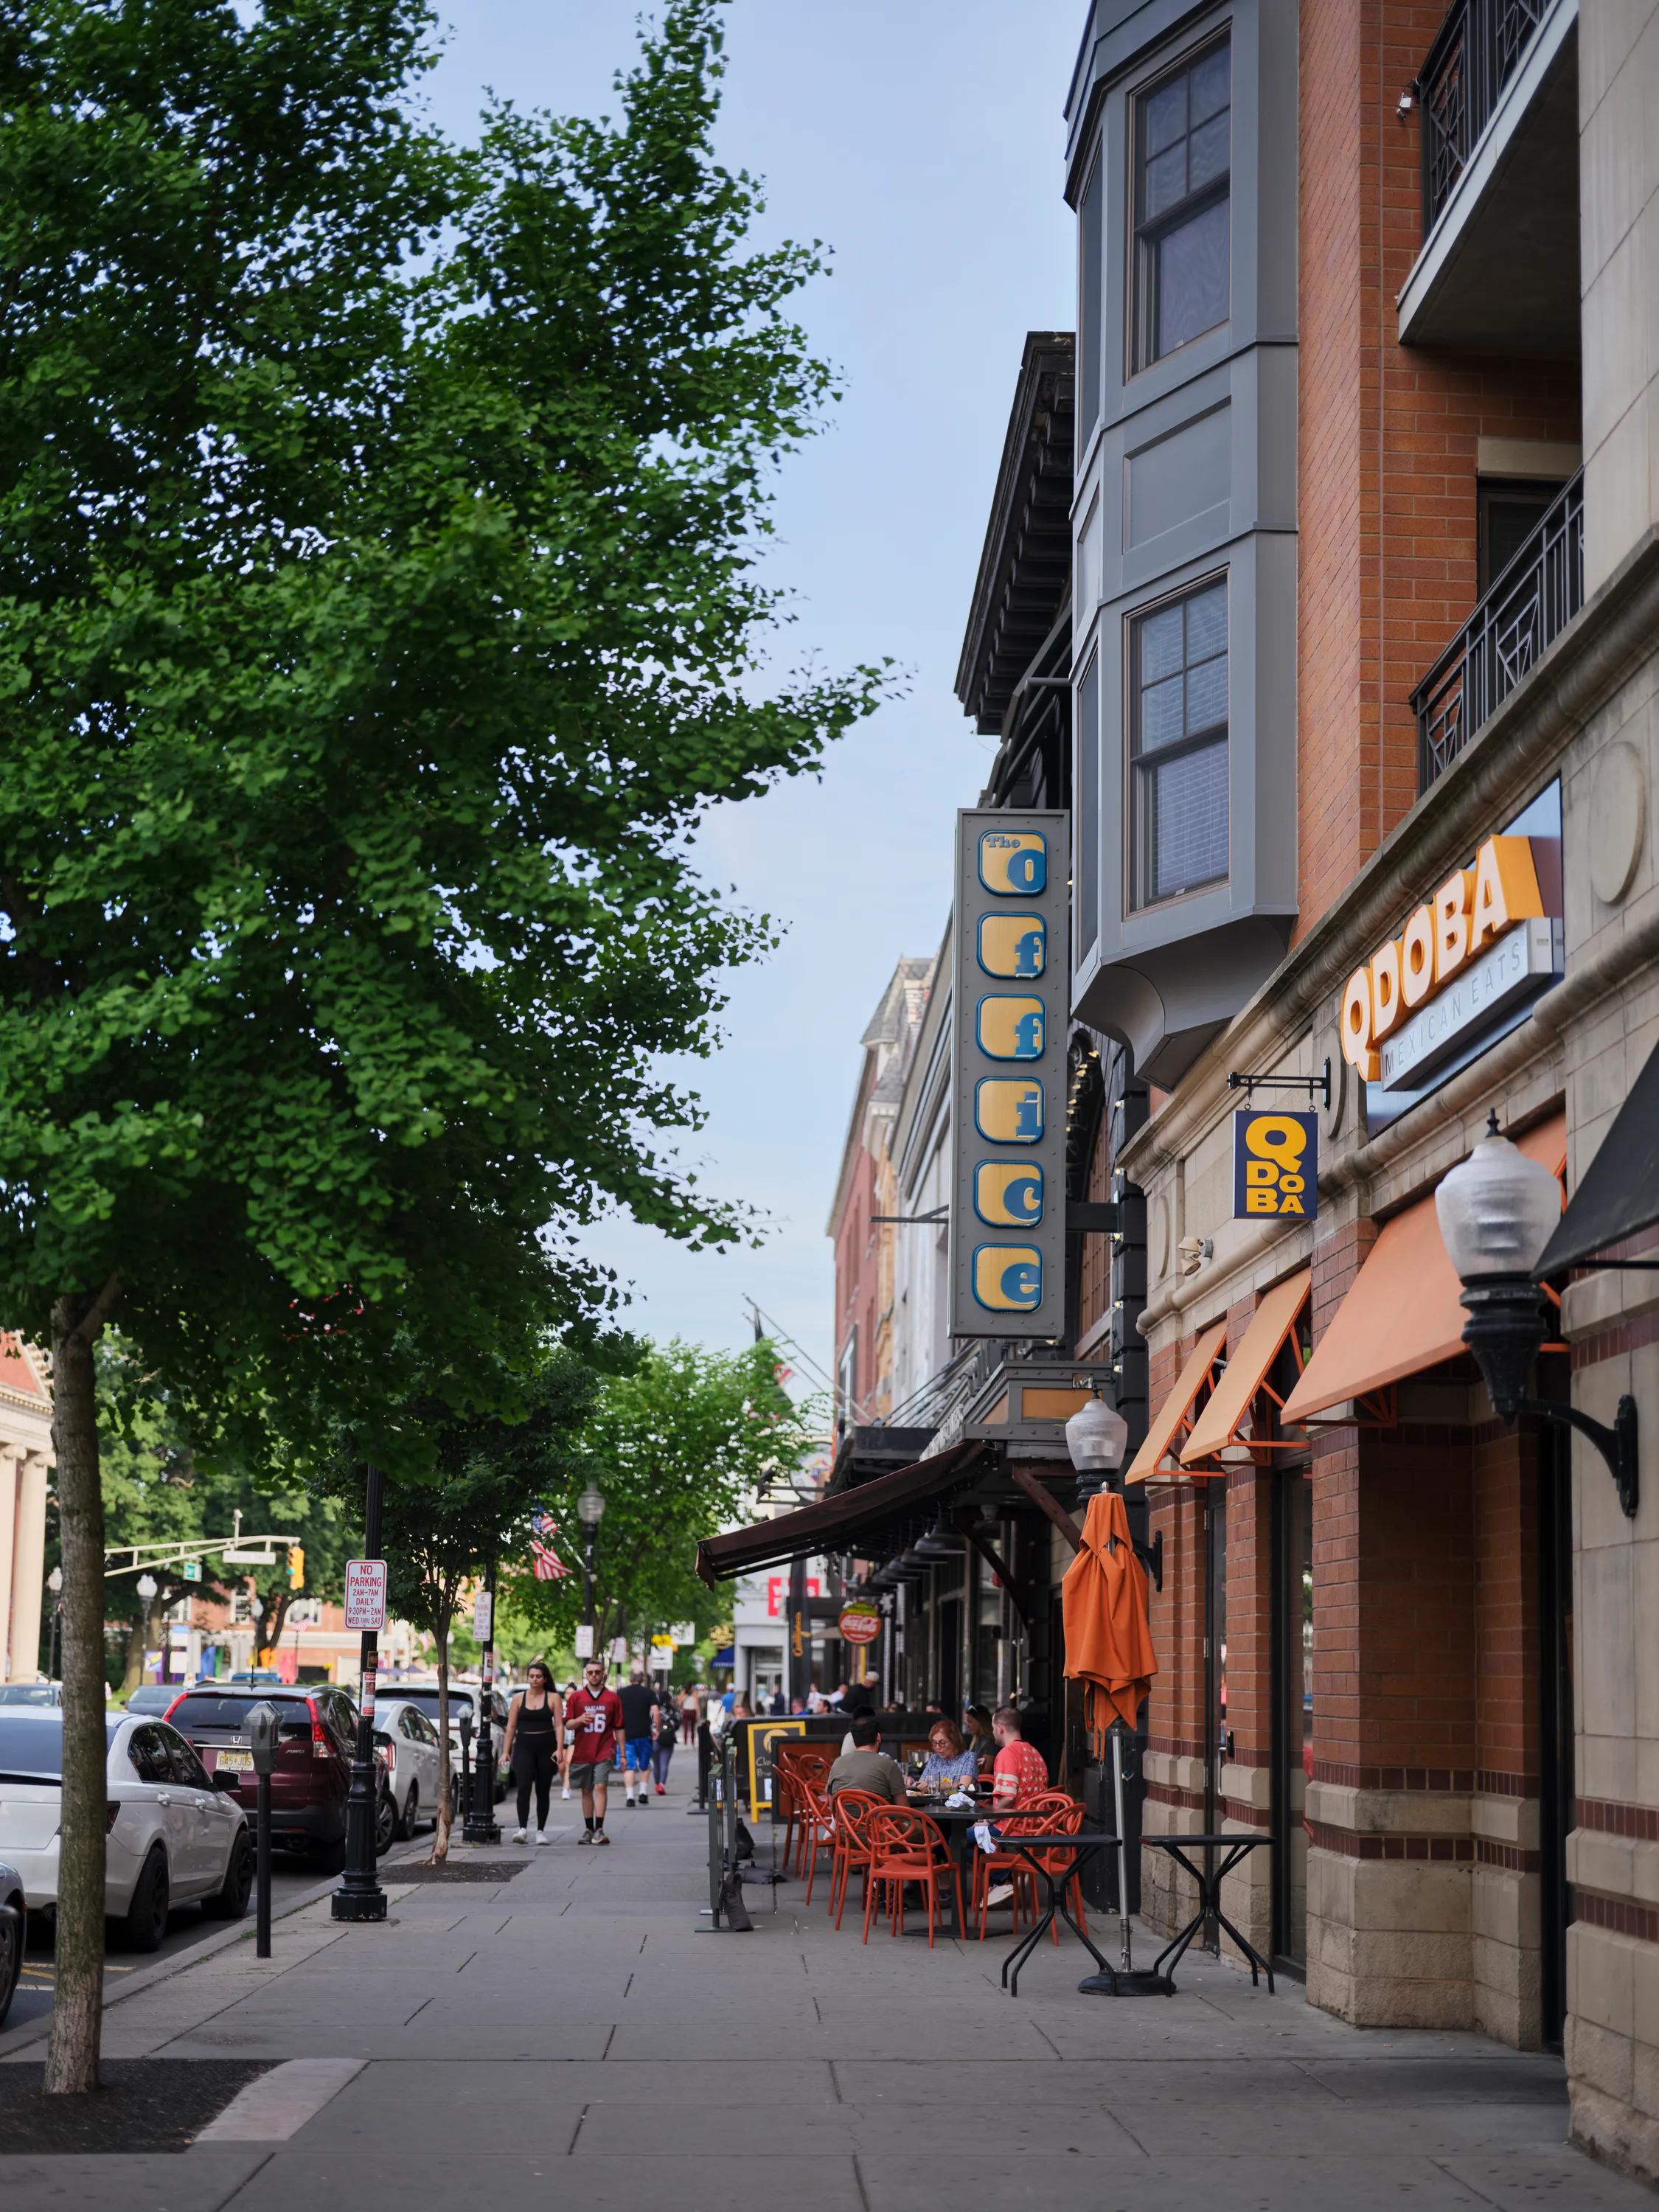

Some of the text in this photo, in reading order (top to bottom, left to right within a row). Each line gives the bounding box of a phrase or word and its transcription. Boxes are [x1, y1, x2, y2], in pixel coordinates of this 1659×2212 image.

[986, 835, 1021, 849] The
[1340, 835, 1526, 1082] QDOBA
[1384, 941, 1522, 1077] MEXICAN EATS
[360, 1565, 372, 1575] NO
[349, 1577, 382, 1587] PARKING
[355, 1597, 375, 1606] DAILY
